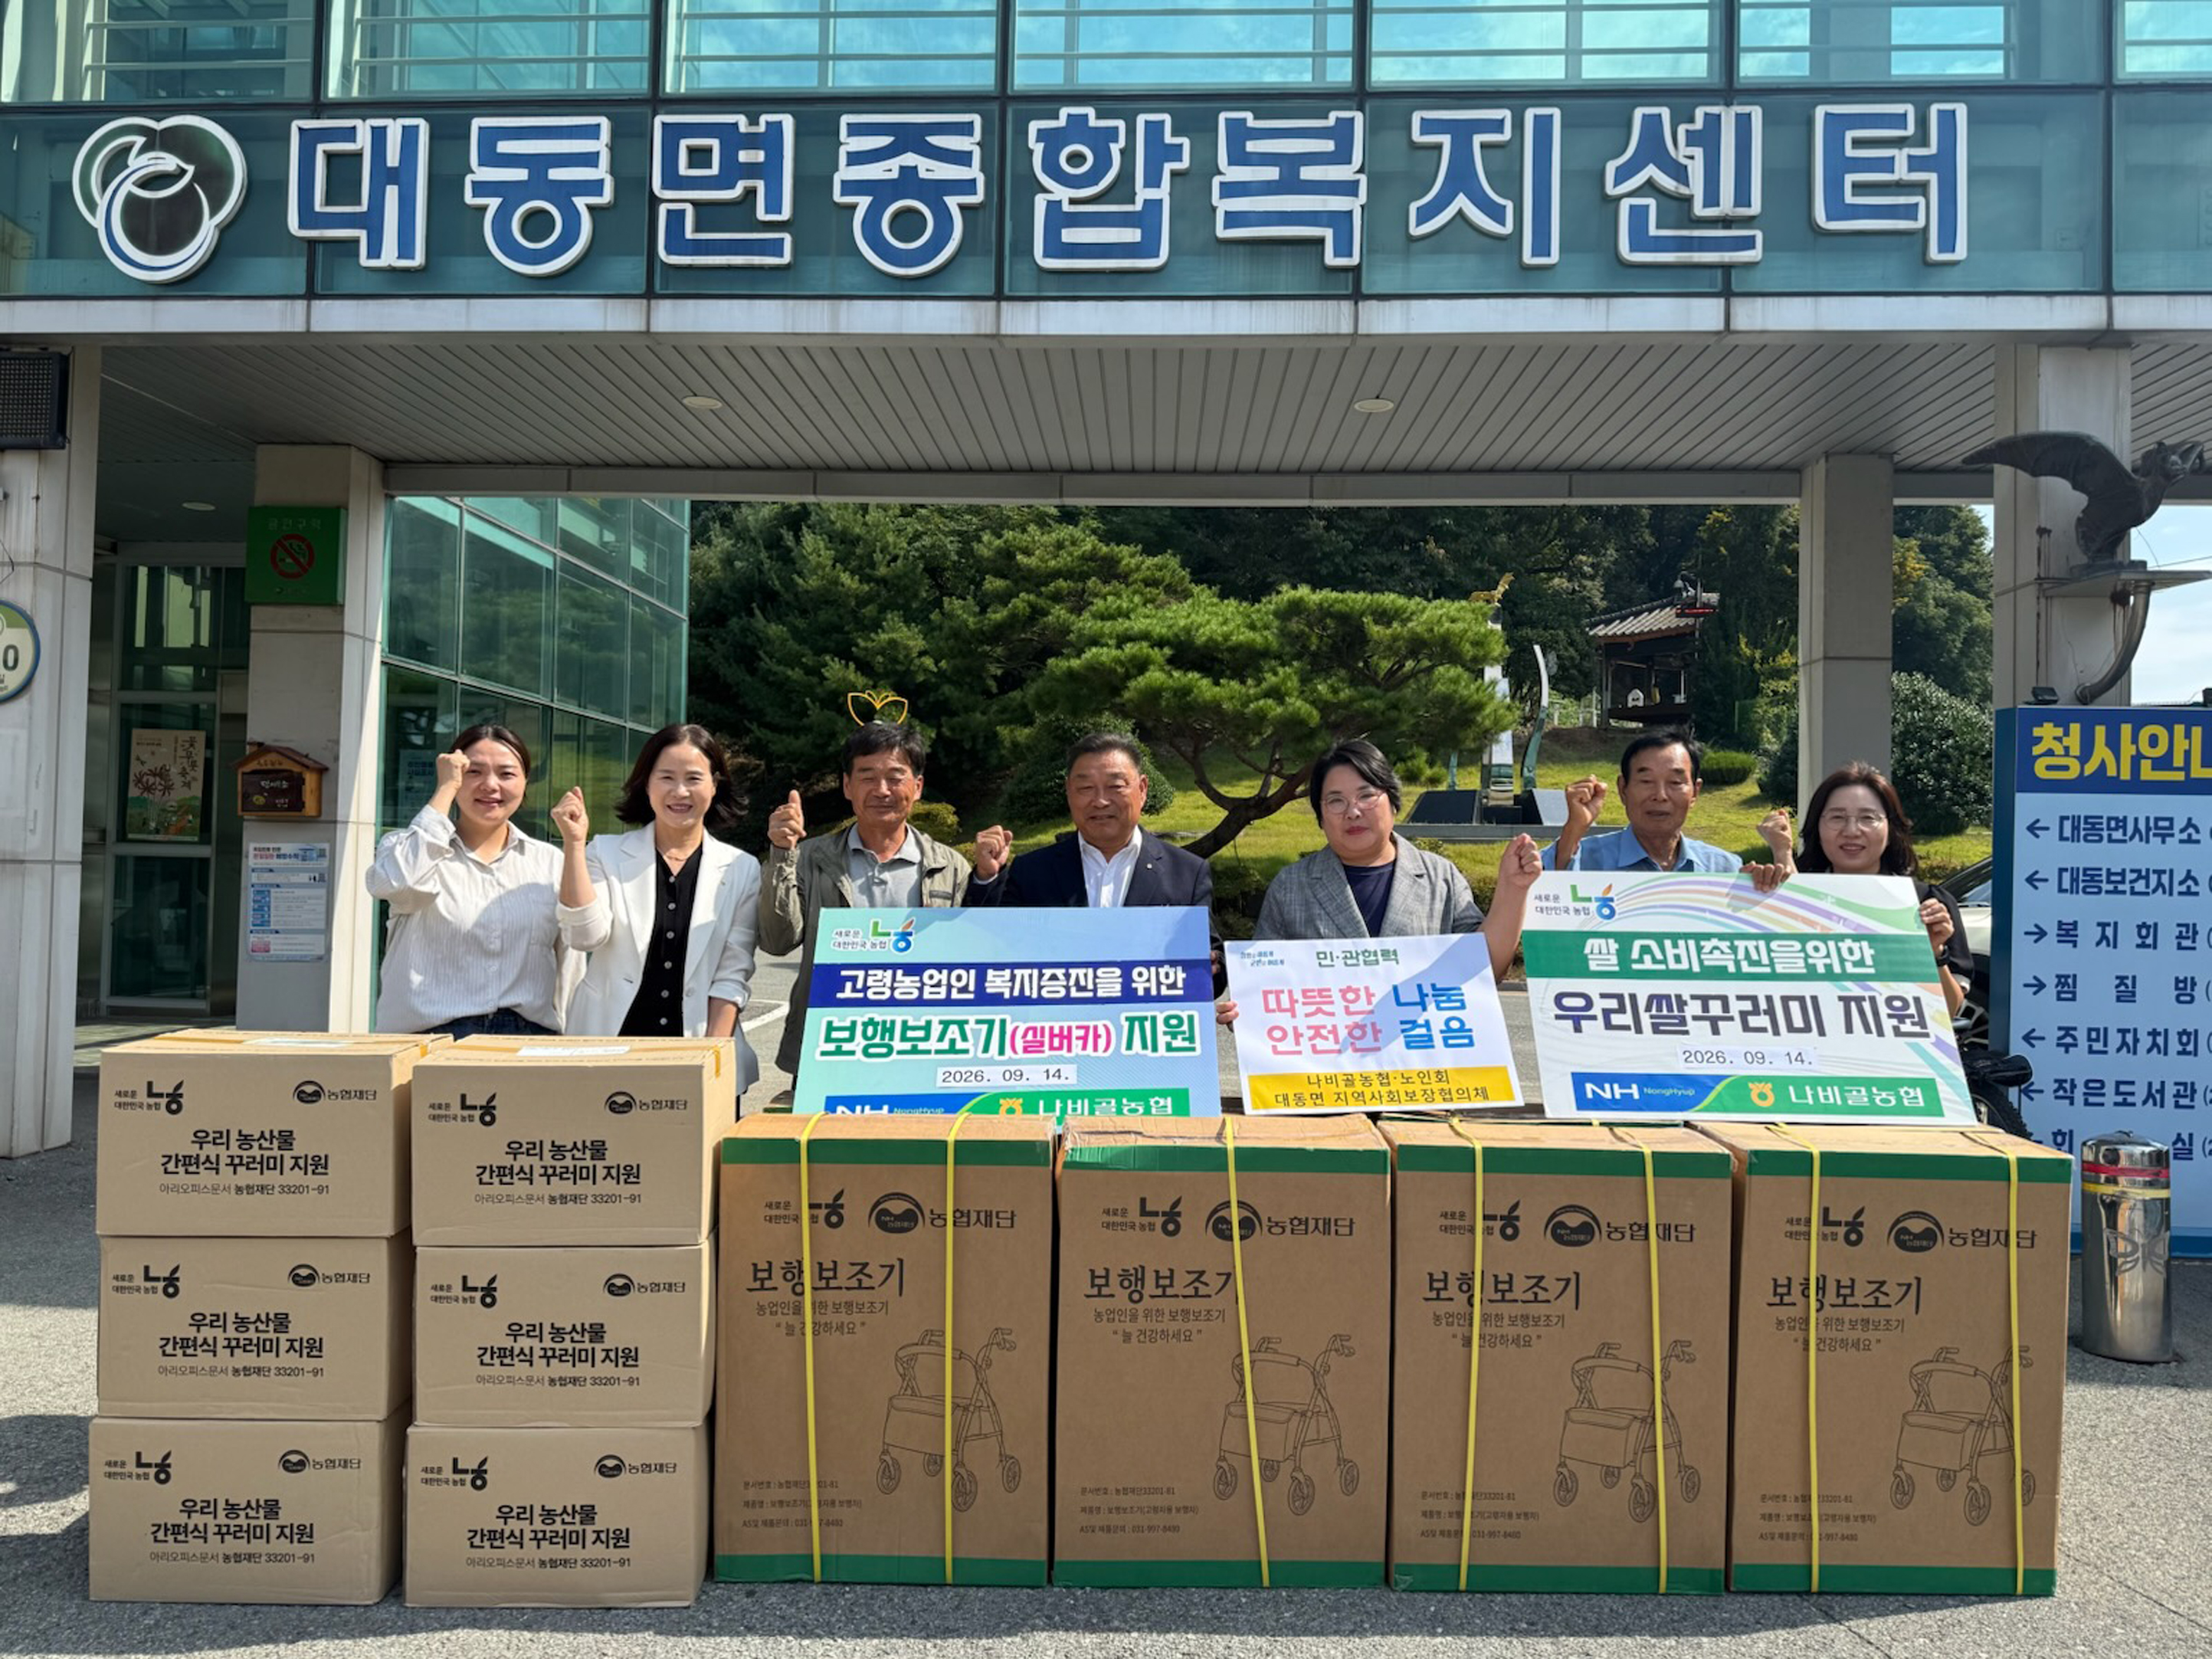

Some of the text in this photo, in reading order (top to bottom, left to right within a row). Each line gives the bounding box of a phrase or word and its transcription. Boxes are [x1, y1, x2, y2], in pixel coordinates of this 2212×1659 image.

[287, 100, 1968, 279] 대동면종합복지센터
[2031, 721, 2212, 782] 청사안
[2057, 814, 2201, 845] 대동면사무소
[2056, 866, 2201, 898] 대동보건지소
[1534, 893, 1561, 903] 새로운
[1535, 905, 1591, 916] 대한민국 농협
[832, 929, 861, 939] 새로운
[832, 939, 887, 950] 대한민국 농협
[1583, 936, 1620, 972] 쌀
[1316, 948, 1401, 969] 민·관협력
[835, 964, 1187, 1001] 고령농업인 복지증진을 위한
[1261, 982, 1468, 1019] 따뜻한 나눔
[1553, 989, 1932, 1040] 우리쌀꾸러미 지원
[818, 1012, 1198, 1060] 보행보조기(실버카) 지원
[1266, 1015, 1476, 1056] 안전한 걸음
[2055, 1025, 2200, 1057] 주민자치회
[1682, 1050, 1814, 1066] 2026. 09. 14.
[942, 1067, 1070, 1084] 2026. 09. 14.
[1306, 1068, 1450, 1090] 나비골농협·노인회
[327, 1089, 377, 1100] 농협재단
[1274, 1085, 1491, 1107] 대동면 지역사회보장협의체
[1584, 1082, 1696, 1100] NH NongHyup
[1788, 1086, 1925, 1108] 나비골농협
[2053, 1077, 2198, 1110] 작은도서관
[113, 1101, 161, 1111] 대한민국 농협
[638, 1099, 688, 1111] 농협재단
[1038, 1096, 1174, 1118] 나비골농협
[428, 1113, 475, 1123] 대한민국 농협
[191, 1129, 296, 1151] 우리 농산물
[505, 1139, 608, 1162] 우리 농산물
[161, 1152, 329, 1176] 간편식 꾸러미 지원
[476, 1163, 641, 1185] 간편식 꾸러미 지원
[234, 1183, 276, 1195] 농협재단
[278, 1184, 329, 1195] 33201-91
[547, 1193, 588, 1205] 농협재단
[591, 1193, 641, 1204] 33201-91
[928, 1208, 1018, 1229] 농협재단
[1101, 1206, 1129, 1218] 새로운
[1101, 1220, 1156, 1232] 대한민국 농협
[1266, 1215, 1356, 1238] 농협재단
[321, 1272, 371, 1284] 농협재단
[637, 1281, 686, 1293] 농협재단
[111, 1285, 159, 1295] 대한민국 농협
[430, 1295, 476, 1304] 대한민국 농협
[831, 1300, 890, 1316] 보행보조기
[1093, 1307, 1227, 1324] 농업인을 위한 보행보조기
[188, 1311, 291, 1334] 우리 농산물
[1507, 1313, 1566, 1329] 보행보조기
[1847, 1316, 1906, 1333] 보행보조기
[505, 1322, 607, 1344] 우리 농산물
[159, 1336, 323, 1359] 간편식 꾸러미 지원
[477, 1345, 639, 1369] 간편식 꾸러미 지원
[231, 1366, 272, 1378] 농협재단
[274, 1366, 324, 1377] 33201-91
[547, 1375, 588, 1388] 농협재단
[589, 1375, 640, 1386] 33201-91
[312, 1457, 362, 1470] 농협재단
[628, 1462, 677, 1474] 농협재단
[103, 1471, 150, 1480] 대한민국 농협
[421, 1477, 467, 1487] 대한민국 농협
[179, 1498, 282, 1520] 우리 농산물
[495, 1503, 598, 1526] 우리 농산물
[151, 1522, 314, 1545] 간편식 꾸러미 지원
[467, 1527, 630, 1550] 간편식 꾸러미 지원
[222, 1552, 263, 1565] 농협재단
[265, 1552, 315, 1563] 33201-91
[538, 1557, 578, 1569] 농협재단
[580, 1557, 631, 1569] 33201-91
